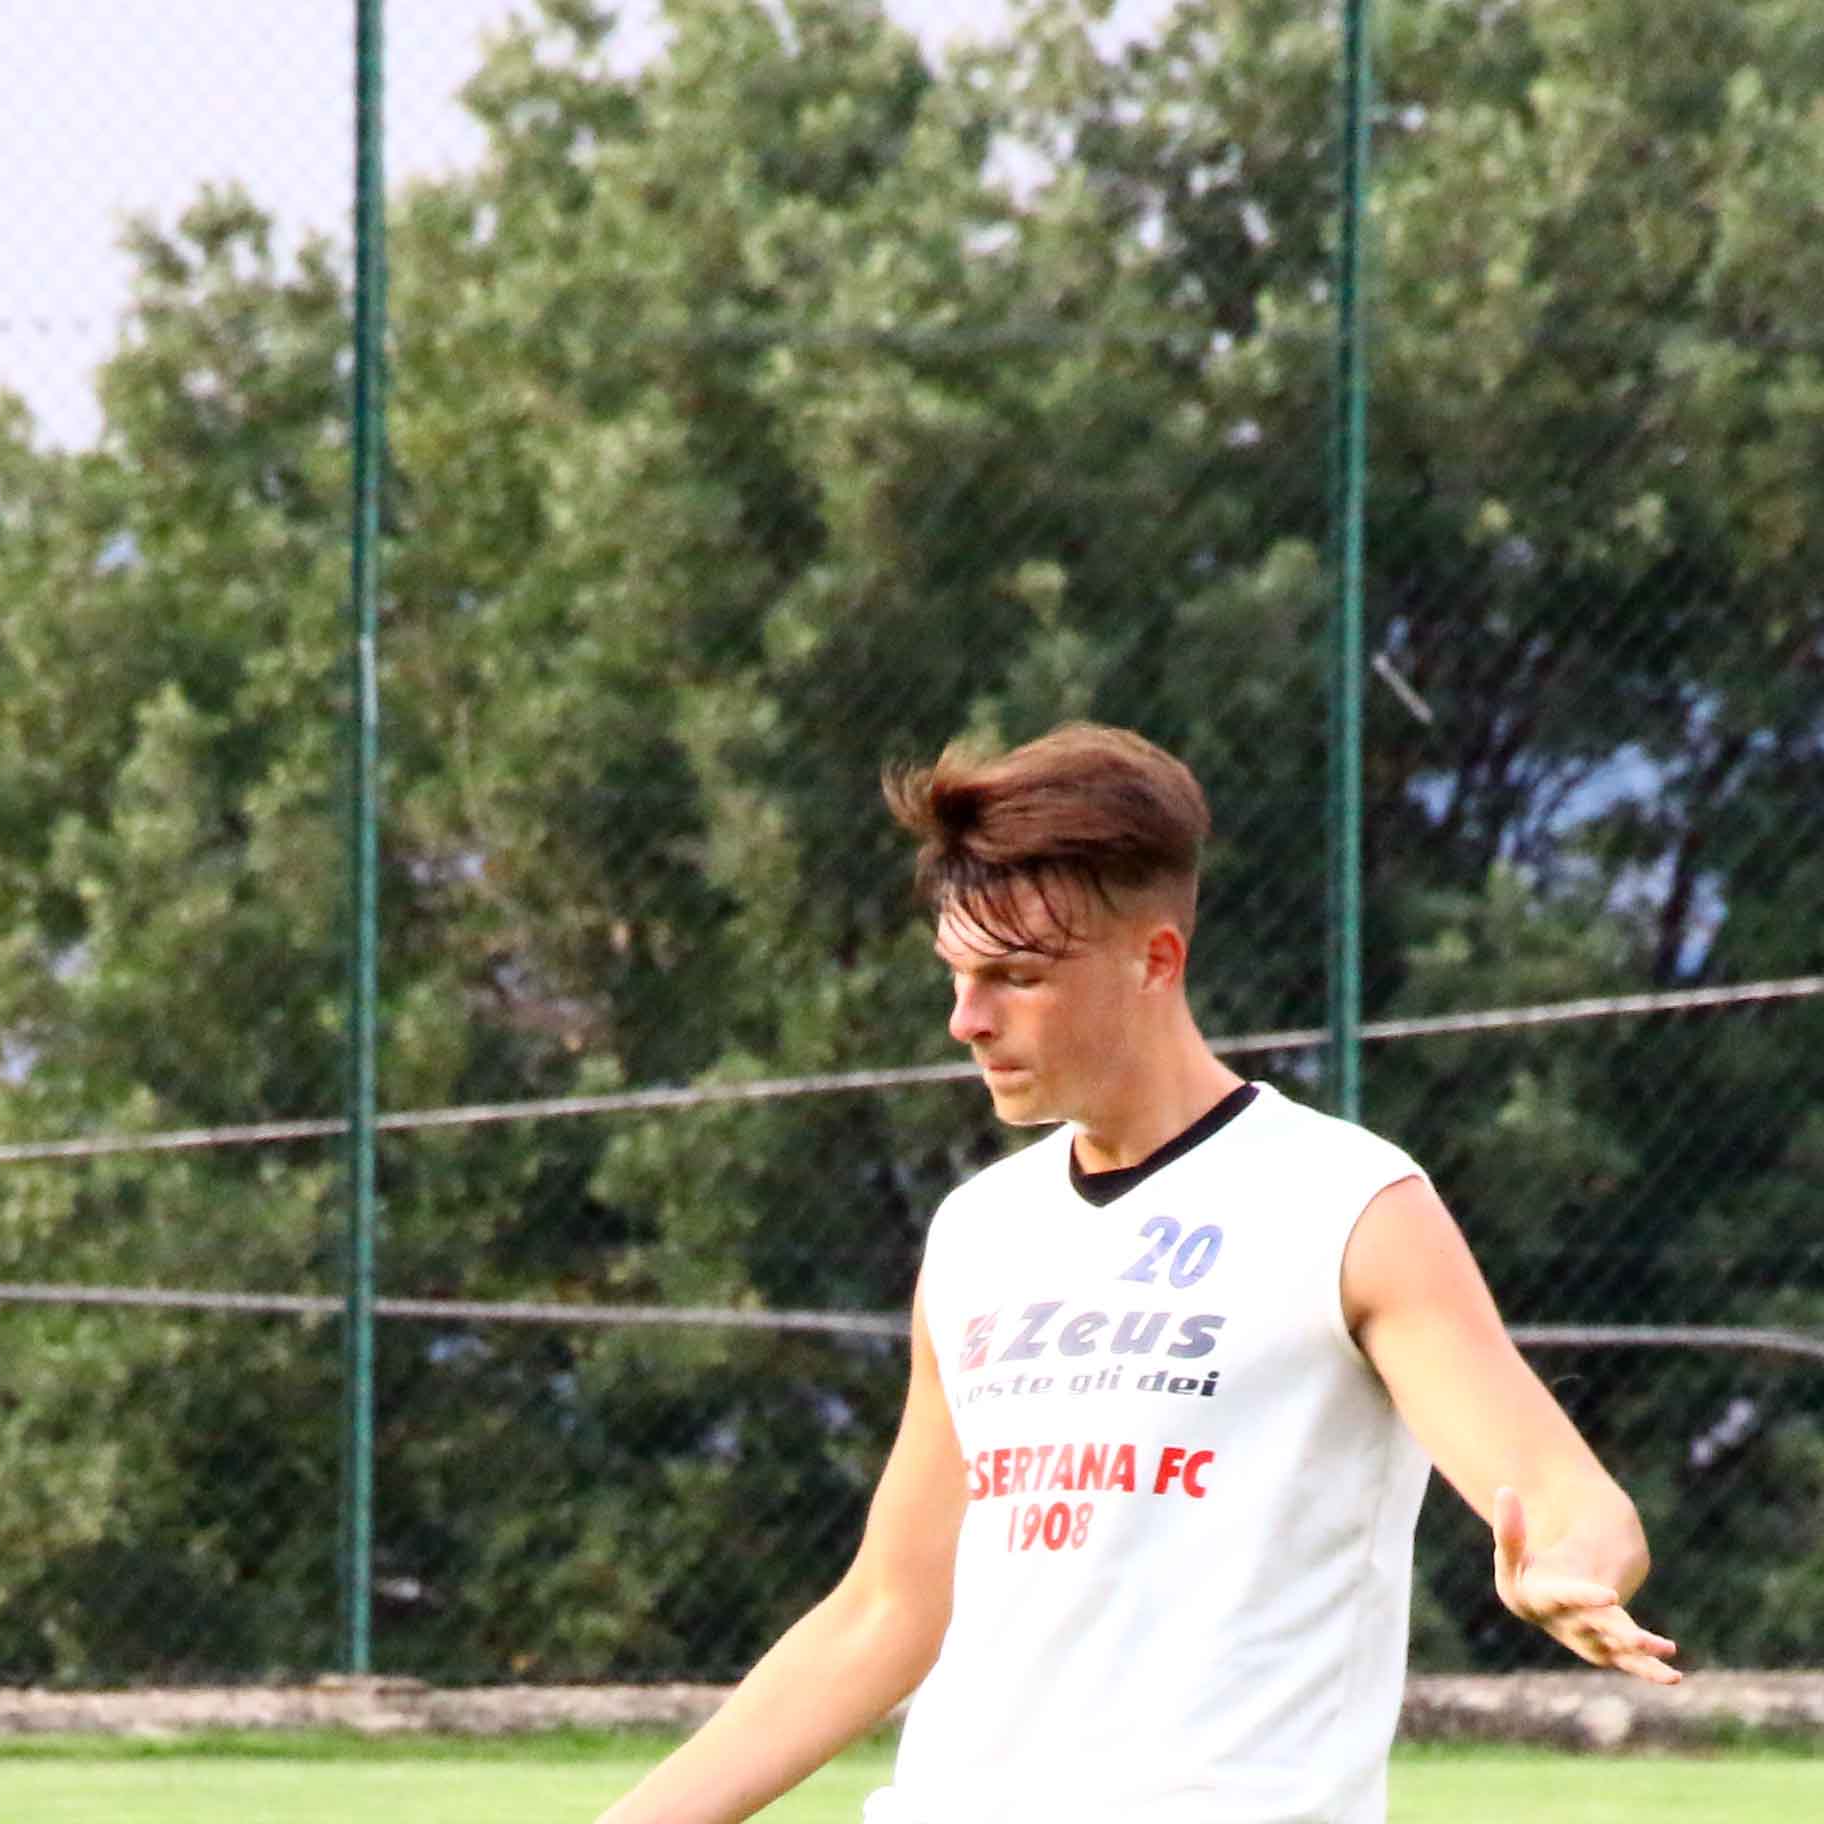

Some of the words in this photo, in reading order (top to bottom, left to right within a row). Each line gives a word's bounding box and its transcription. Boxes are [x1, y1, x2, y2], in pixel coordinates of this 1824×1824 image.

[1117, 1216, 1224, 1289] 20
[998, 1301, 1226, 1361] Zeus
[1070, 1365, 1124, 1397] gli
[1136, 1371, 1219, 1397] dei
[1153, 1447, 1215, 1498] FC
[1008, 1501, 1094, 1553] 1908
